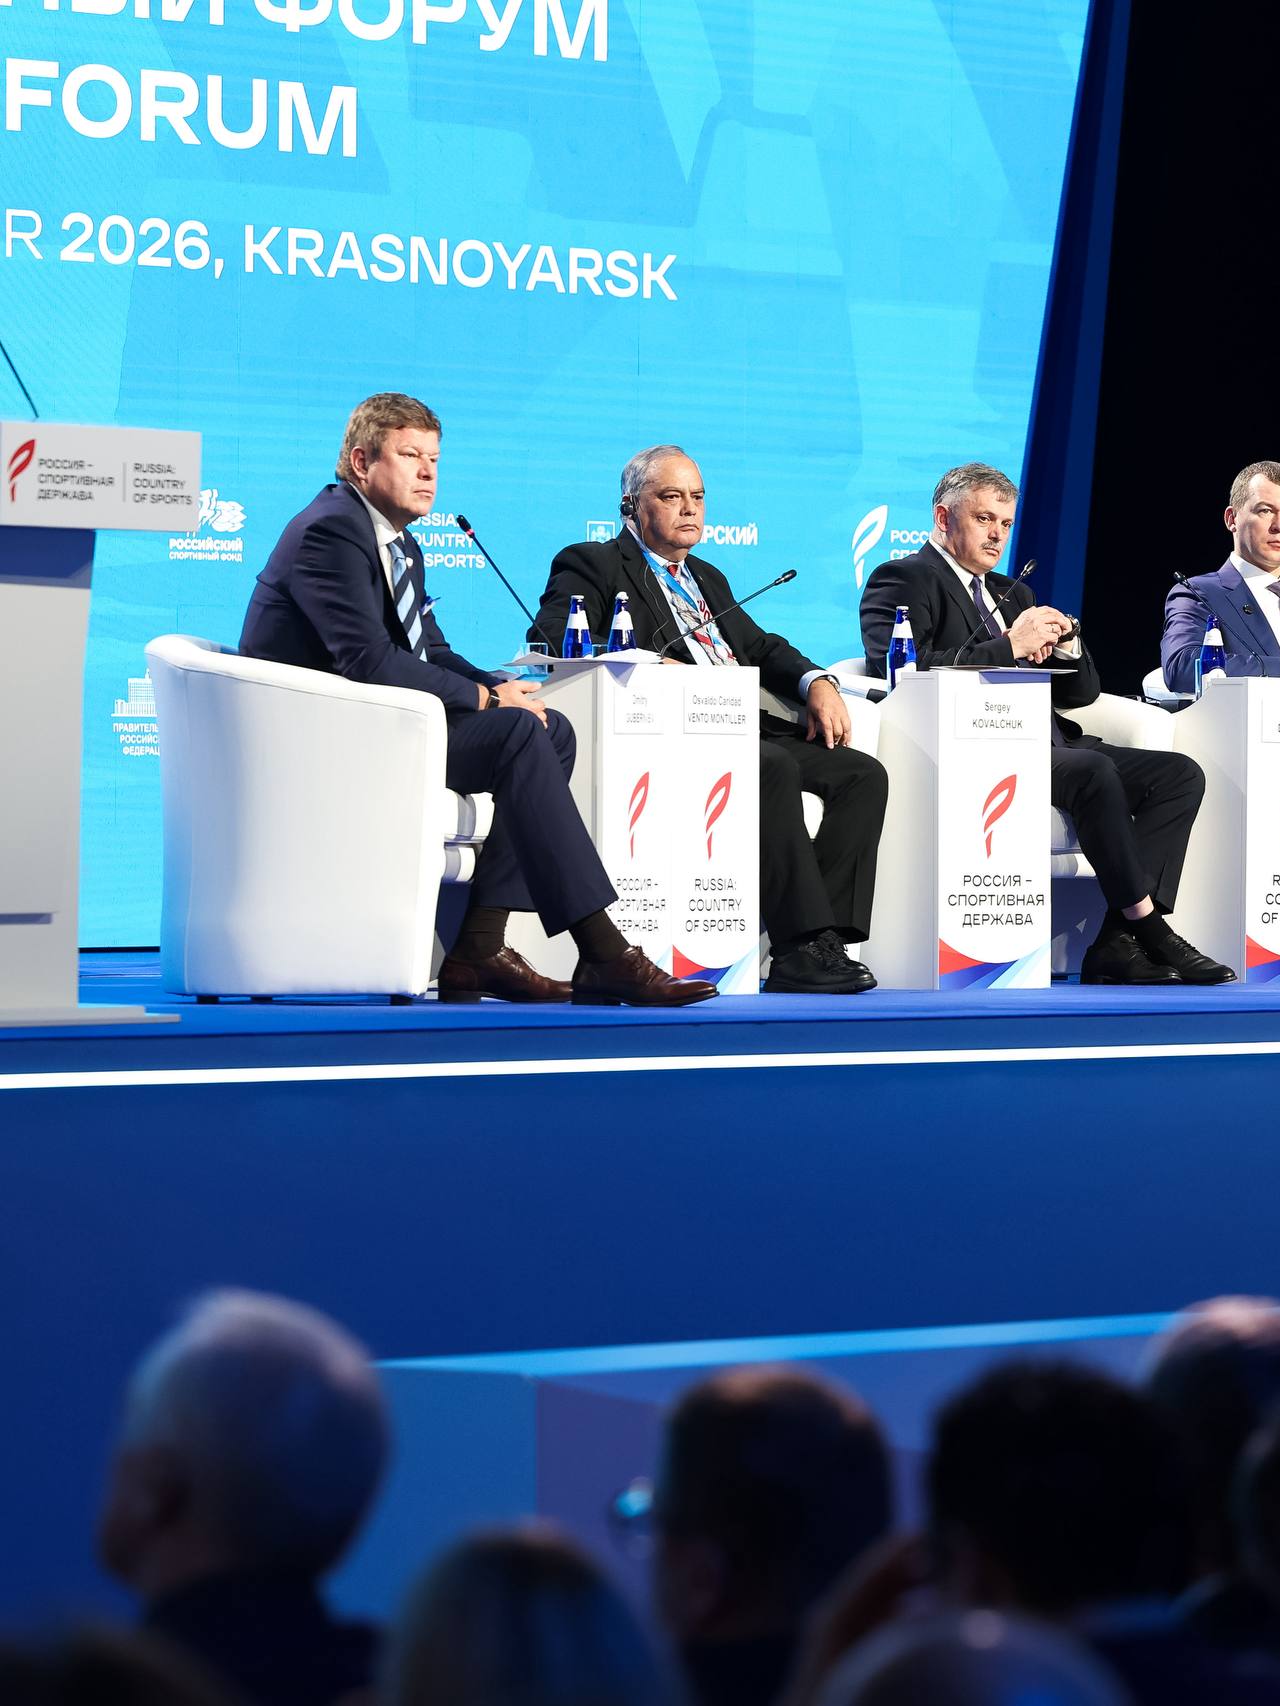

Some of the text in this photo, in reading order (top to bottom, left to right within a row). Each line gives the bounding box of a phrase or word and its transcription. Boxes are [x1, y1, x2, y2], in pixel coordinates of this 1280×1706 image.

[5, 57, 357, 158] FORUM
[59, 212, 224, 279] 2026,
[244, 224, 678, 301] KRASNOYARSK
[38, 458, 86, 470] РОССИЯ
[133, 462, 176, 474] RUSSIA:
[38, 473, 115, 487] СПОРТИВНАЯ
[133, 478, 187, 490] COUNTRY
[37, 489, 94, 502] ДЕРЖАВА
[133, 493, 193, 506] OF SPORTS
[168, 536, 244, 552] РОССИЙСКИЙ
[168, 551, 244, 563] СПОРТИВНЫЙ ФОНД
[424, 552, 486, 569] SPORTS
[692, 694, 717, 706] Osvaldo
[984, 701, 1011, 714] Sergey
[688, 712, 746, 725] VENTO MONTILLER
[972, 718, 1023, 729] KOVALCHUK
[616, 877, 652, 892] РОССИЯ
[694, 877, 737, 892] RUSSIA:
[963, 875, 1022, 887] РОССИЯ
[688, 898, 742, 912] COUNTRY
[947, 894, 1045, 907] СПОРТИВНАЯ
[962, 913, 1034, 928] ДЕРЖАВА
[1261, 912, 1279, 924] OF
[685, 918, 746, 932] OF SPORTS
